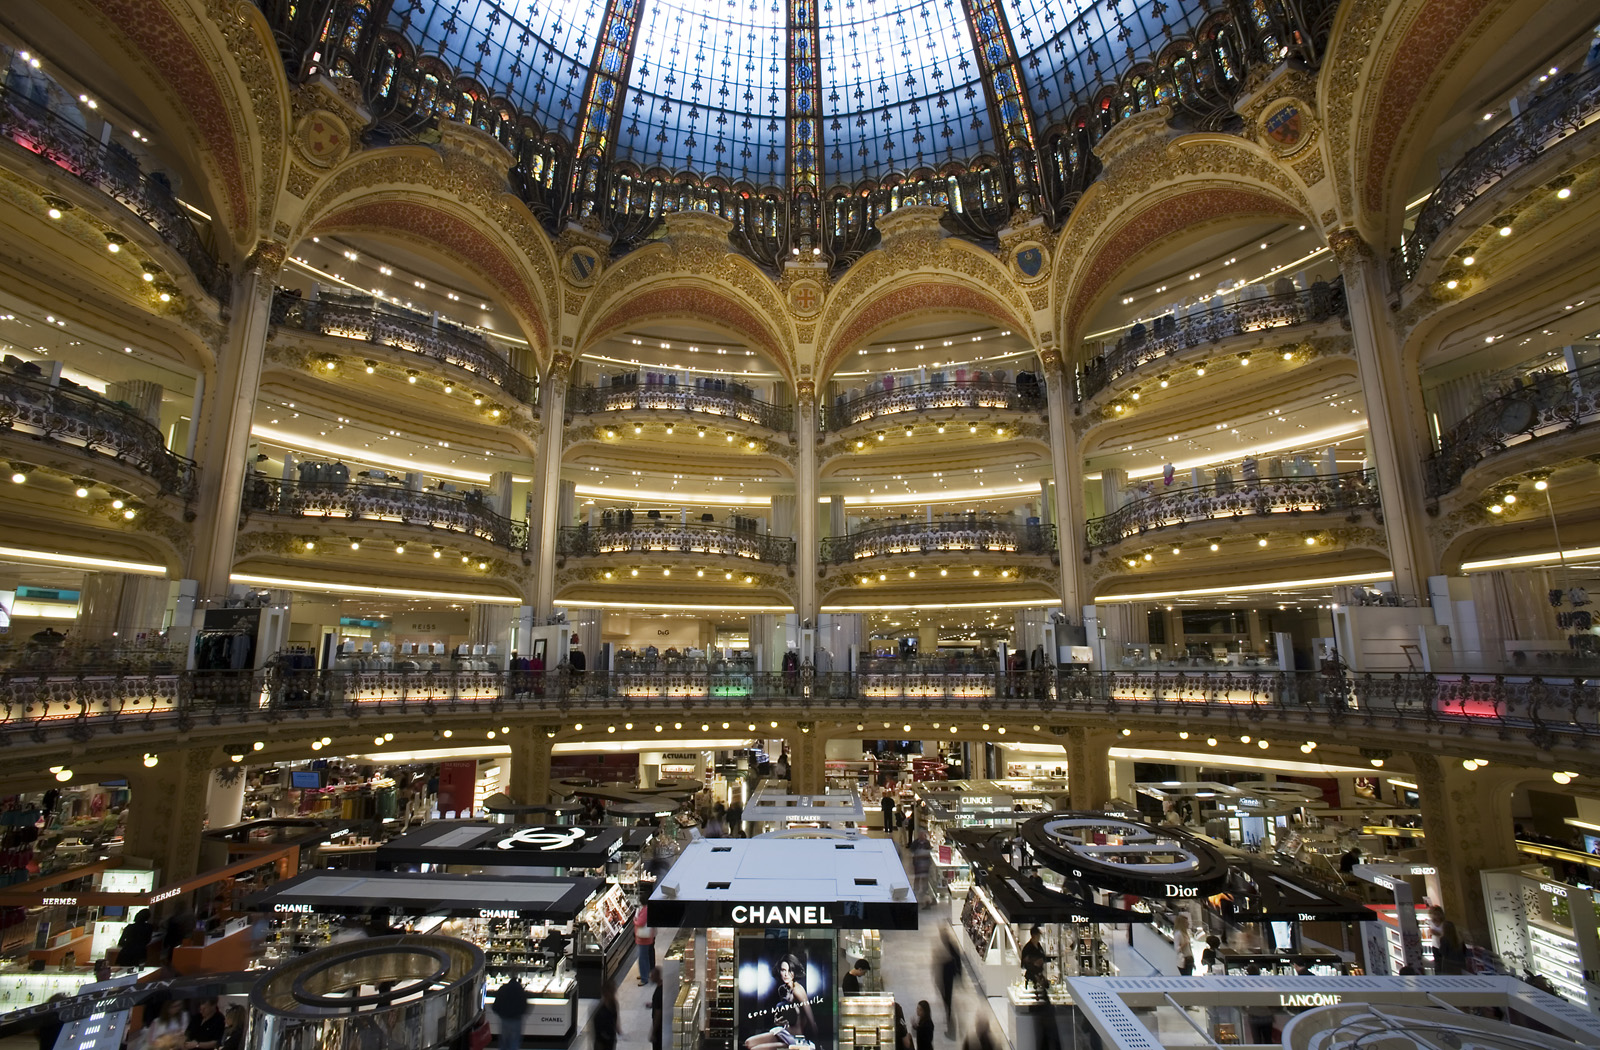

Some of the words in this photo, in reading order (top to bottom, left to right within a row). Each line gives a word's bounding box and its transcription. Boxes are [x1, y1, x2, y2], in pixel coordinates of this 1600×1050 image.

[962, 796, 992, 804] CLINIQUE
[1374, 876, 1394, 890] KENZO
[1165, 884, 1198, 896] Dior
[1540, 883, 1567, 897] KENZO
[274, 904, 314, 912] CHANEL
[480, 910, 520, 918] CHANEL
[732, 906, 832, 924] CHANEL
